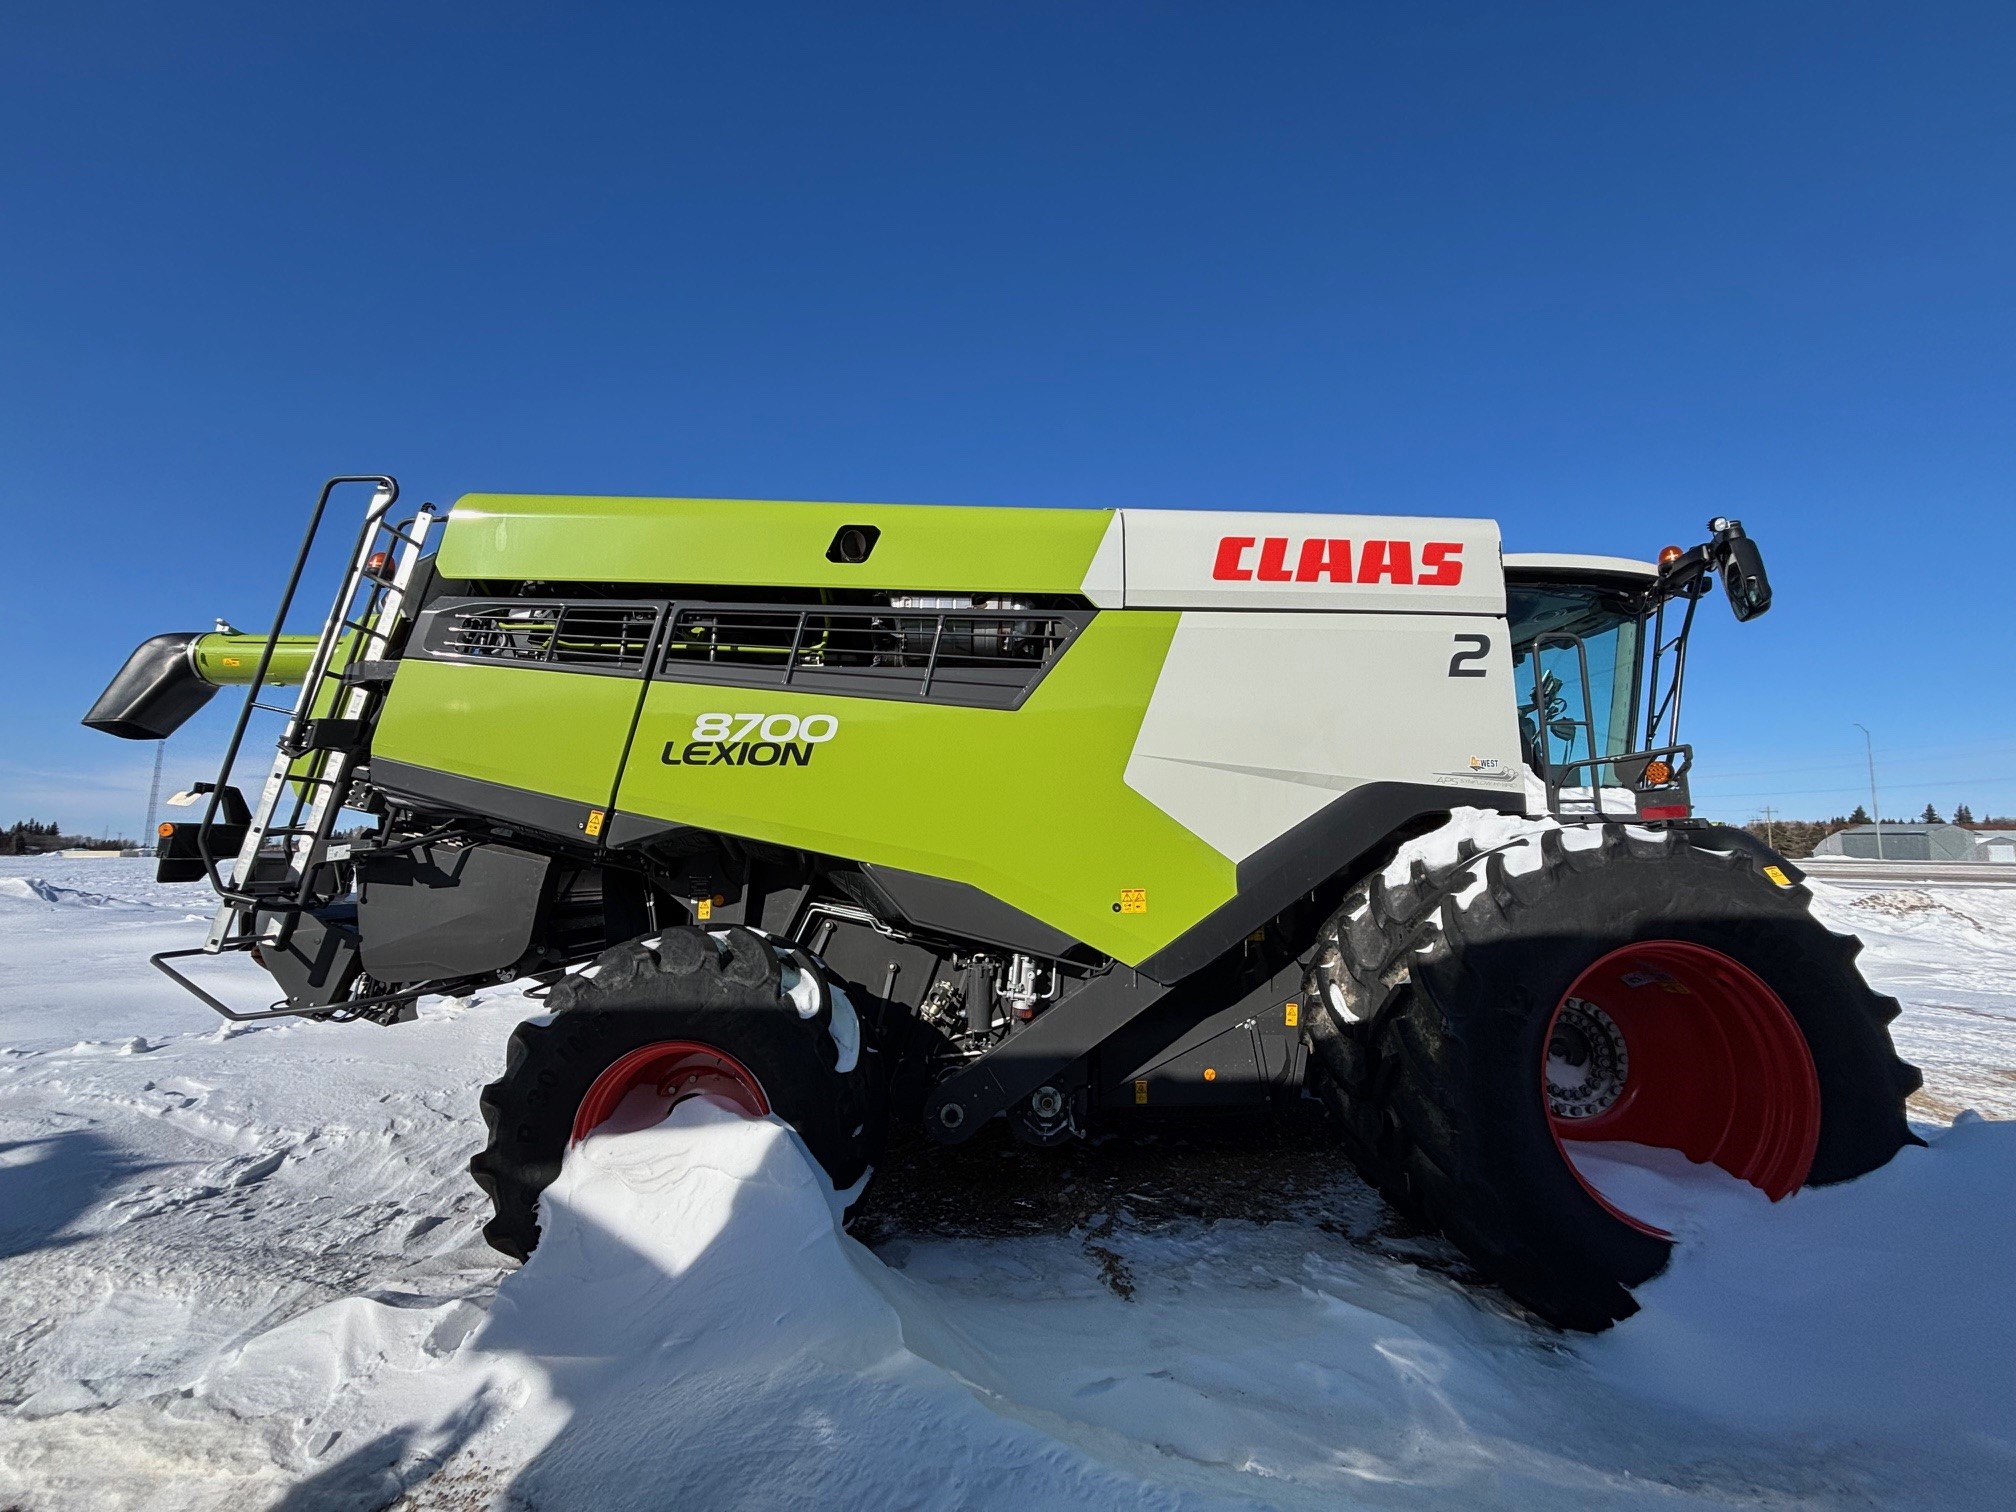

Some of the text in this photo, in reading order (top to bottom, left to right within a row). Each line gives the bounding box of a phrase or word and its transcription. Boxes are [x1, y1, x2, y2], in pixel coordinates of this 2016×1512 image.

[1212, 537, 1463, 586] CLAAS
[1448, 634, 1491, 677] 2
[692, 713, 838, 742] 8700
[661, 741, 814, 766] LEXION
